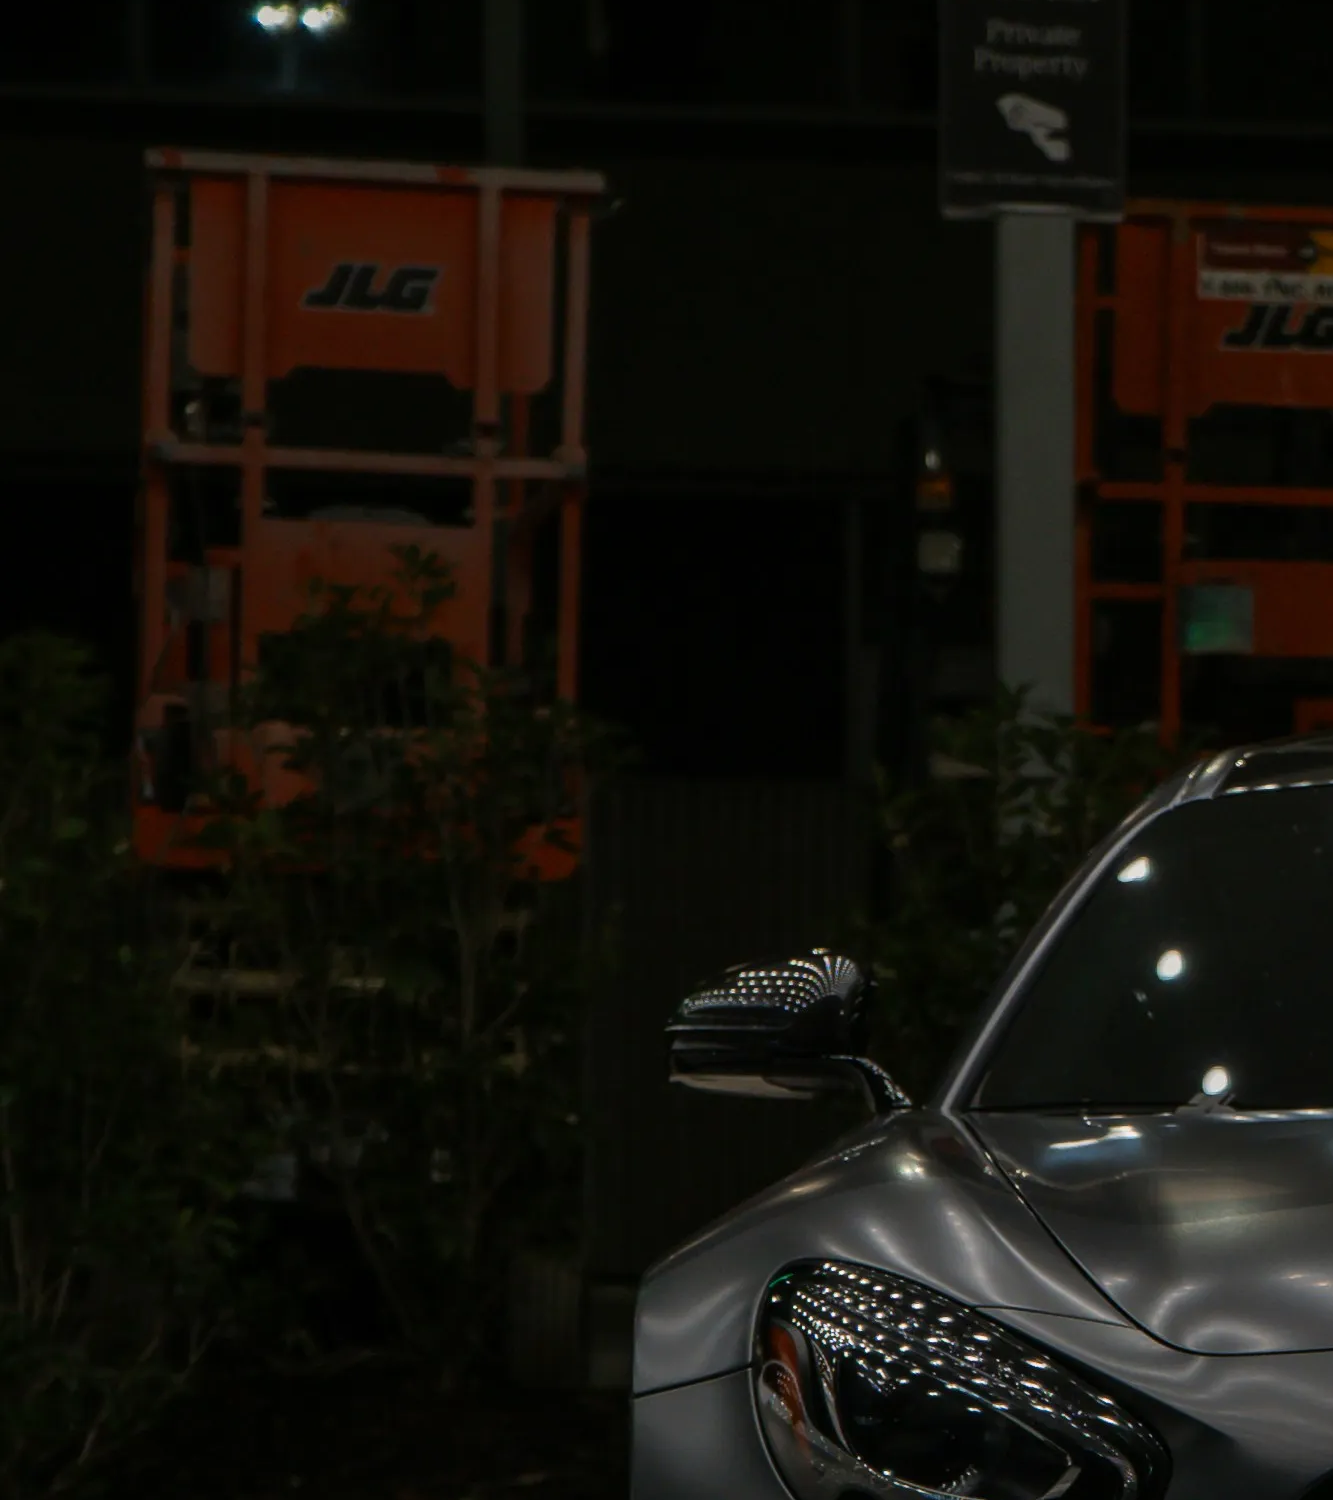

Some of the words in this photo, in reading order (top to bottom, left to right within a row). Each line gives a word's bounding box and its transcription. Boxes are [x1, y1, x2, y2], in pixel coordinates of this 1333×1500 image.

[986, 17, 1083, 46] Private
[974, 47, 1090, 82] Property
[302, 262, 440, 314] JLG
